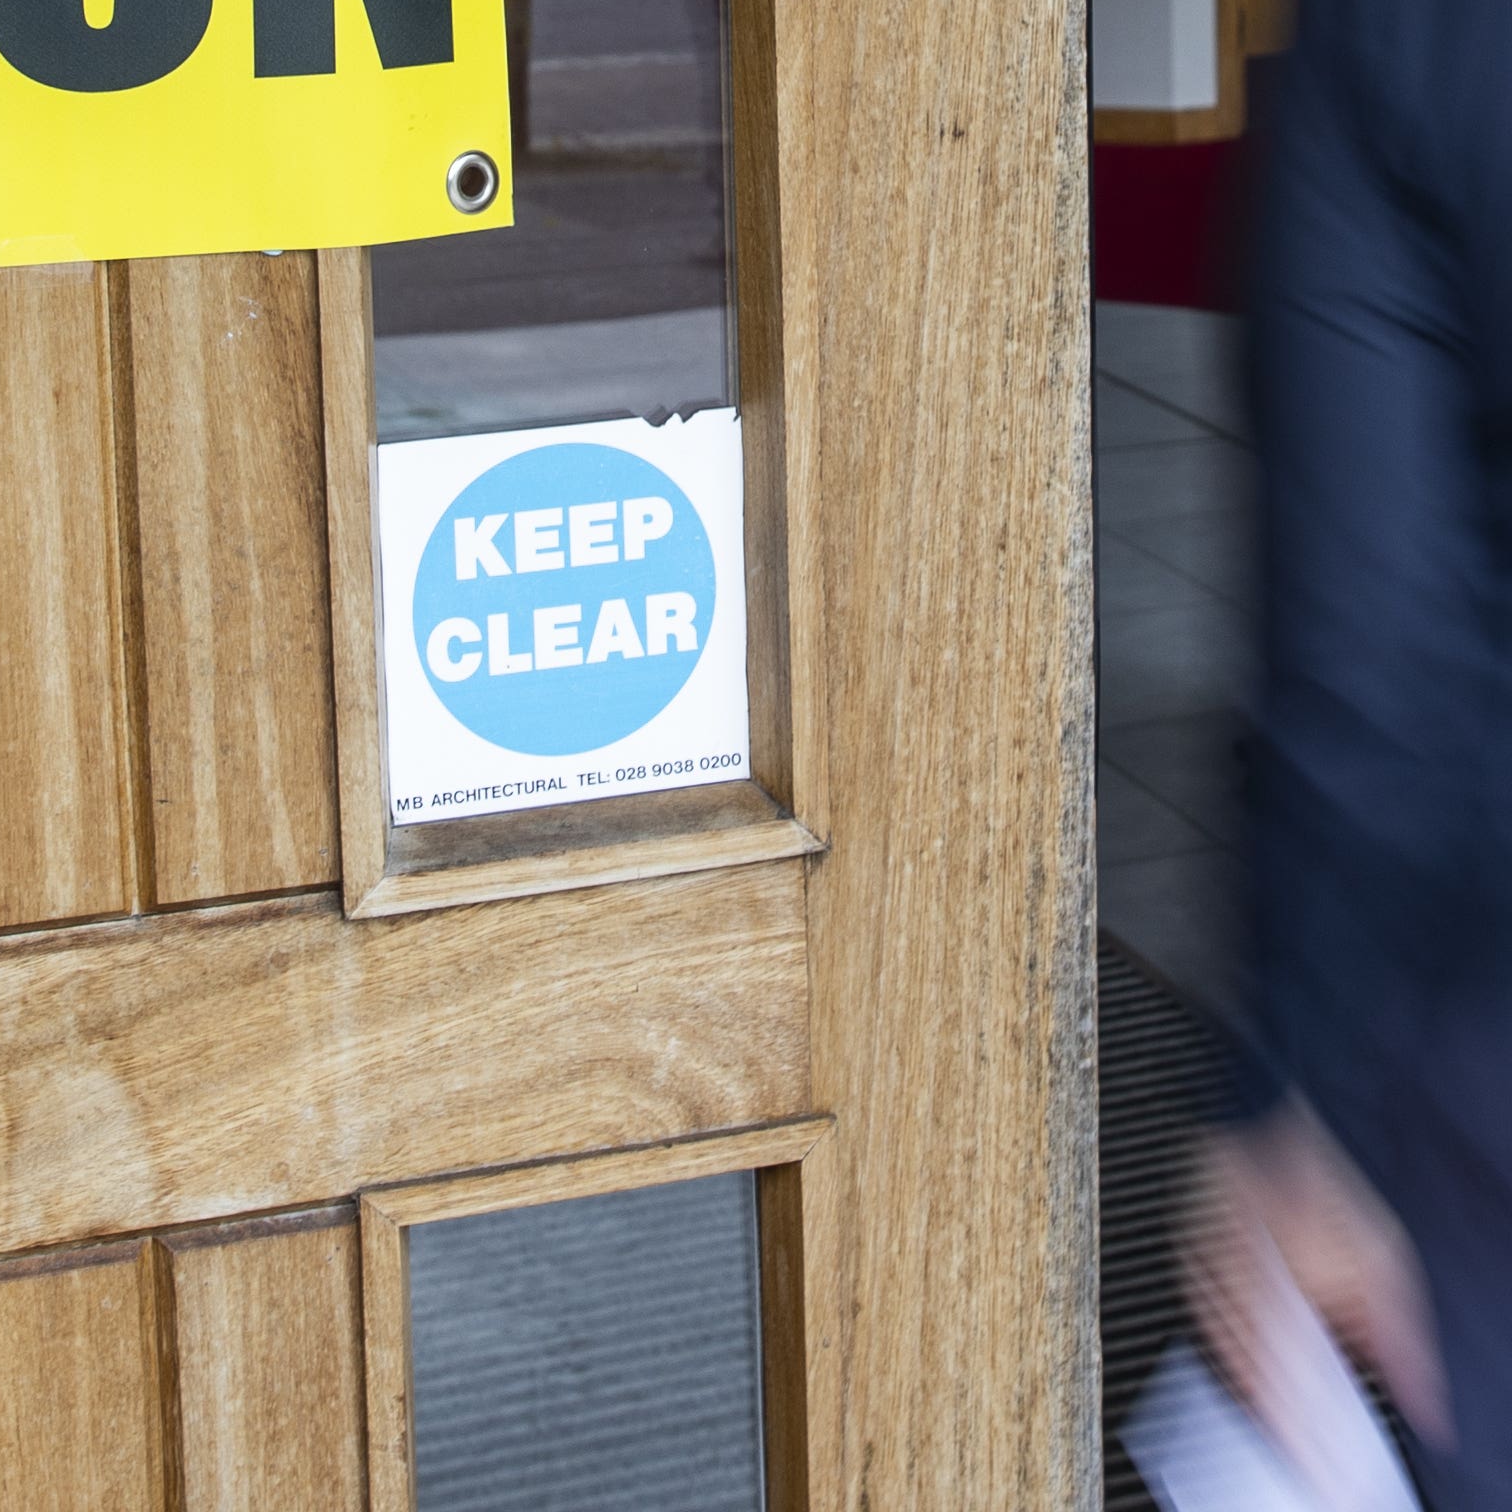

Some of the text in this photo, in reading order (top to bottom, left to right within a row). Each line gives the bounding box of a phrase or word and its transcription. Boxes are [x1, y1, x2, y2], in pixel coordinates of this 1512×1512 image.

[454, 496, 674, 582] KEEP
[426, 591, 699, 683] CLEAR
[396, 752, 743, 812] MB ARCHITECTURAL TEL: 028 9038 0200
